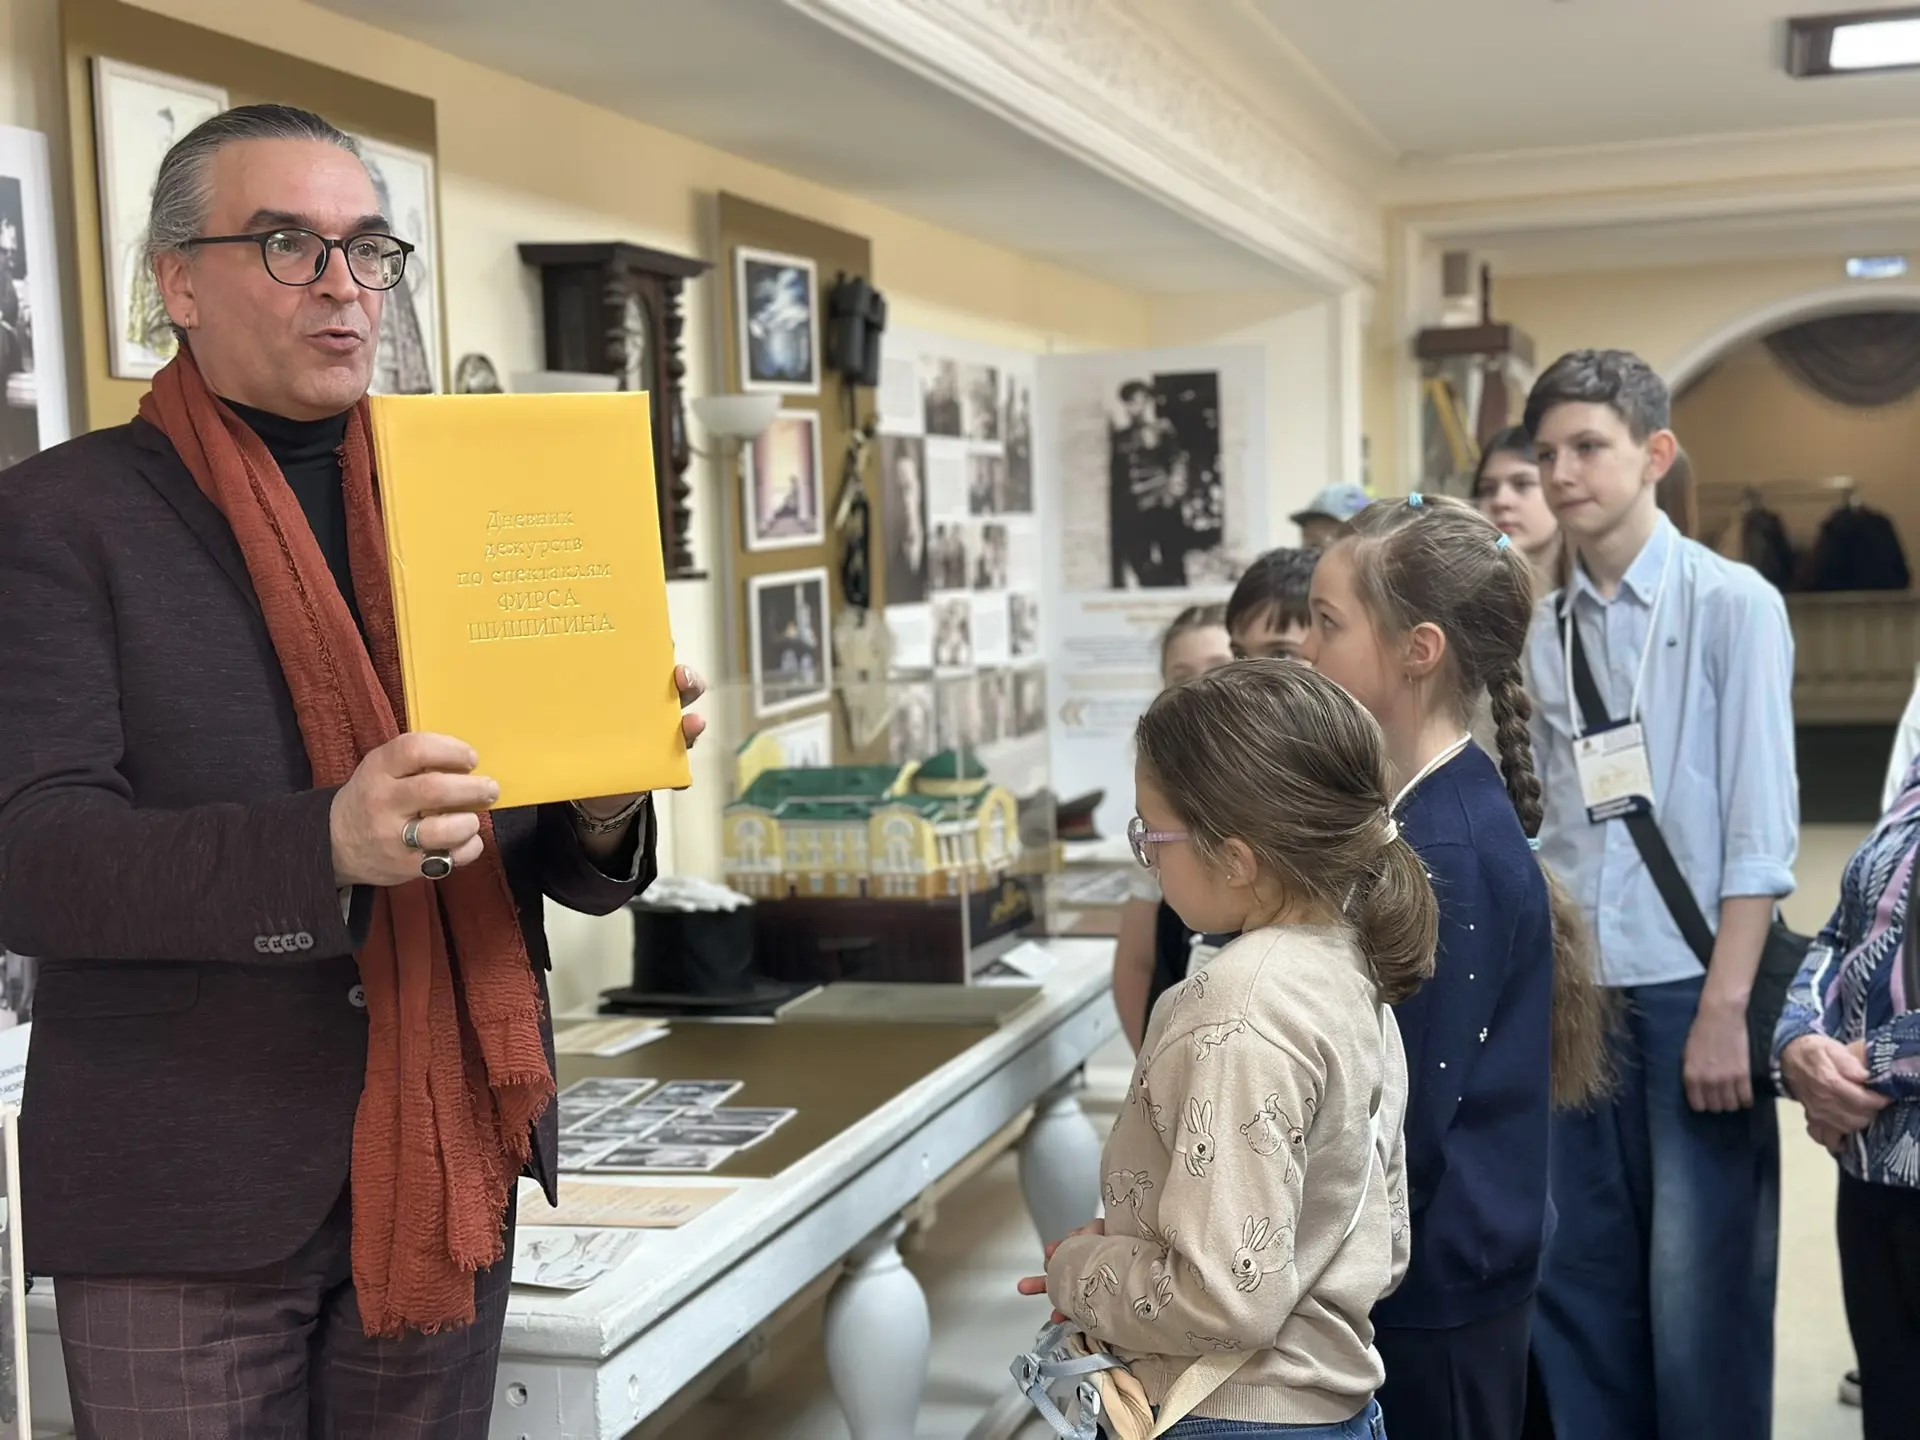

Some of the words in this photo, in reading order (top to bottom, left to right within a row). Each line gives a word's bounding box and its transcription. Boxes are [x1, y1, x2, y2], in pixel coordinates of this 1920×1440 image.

[487, 510, 574, 533] Дневник
[485, 537, 583, 560] дежурств
[456, 572, 483, 586] по
[491, 563, 613, 584] спектаклям
[497, 588, 581, 612] ФИРСА
[467, 614, 615, 642] ШИШИГИНА
